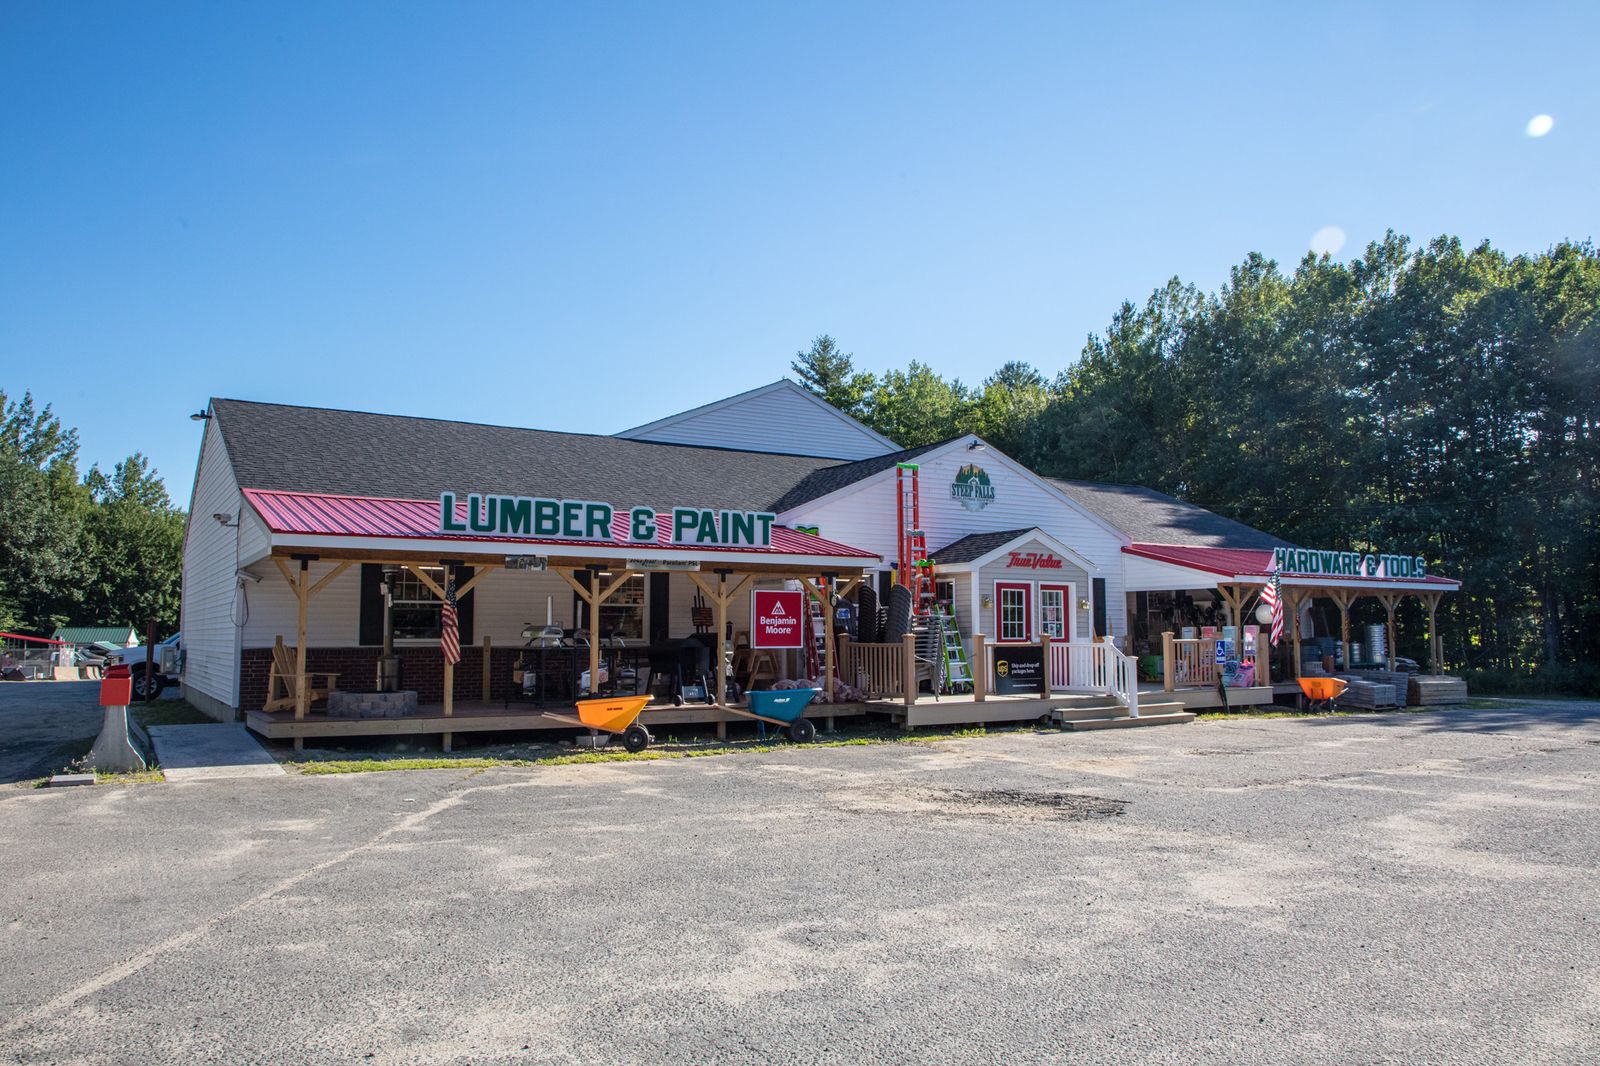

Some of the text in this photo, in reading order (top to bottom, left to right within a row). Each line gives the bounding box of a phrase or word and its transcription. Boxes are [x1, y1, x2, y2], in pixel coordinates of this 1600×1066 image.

[952, 483, 973, 497] STEEP
[975, 486, 995, 499] FALLS
[443, 495, 775, 546] LUMBER & PAINT
[1006, 551, 1062, 570] True Value
[1275, 549, 1425, 578] HARDWARE & TOOLS
[760, 615, 797, 627] Benjamin
[765, 626, 791, 634] Moore
